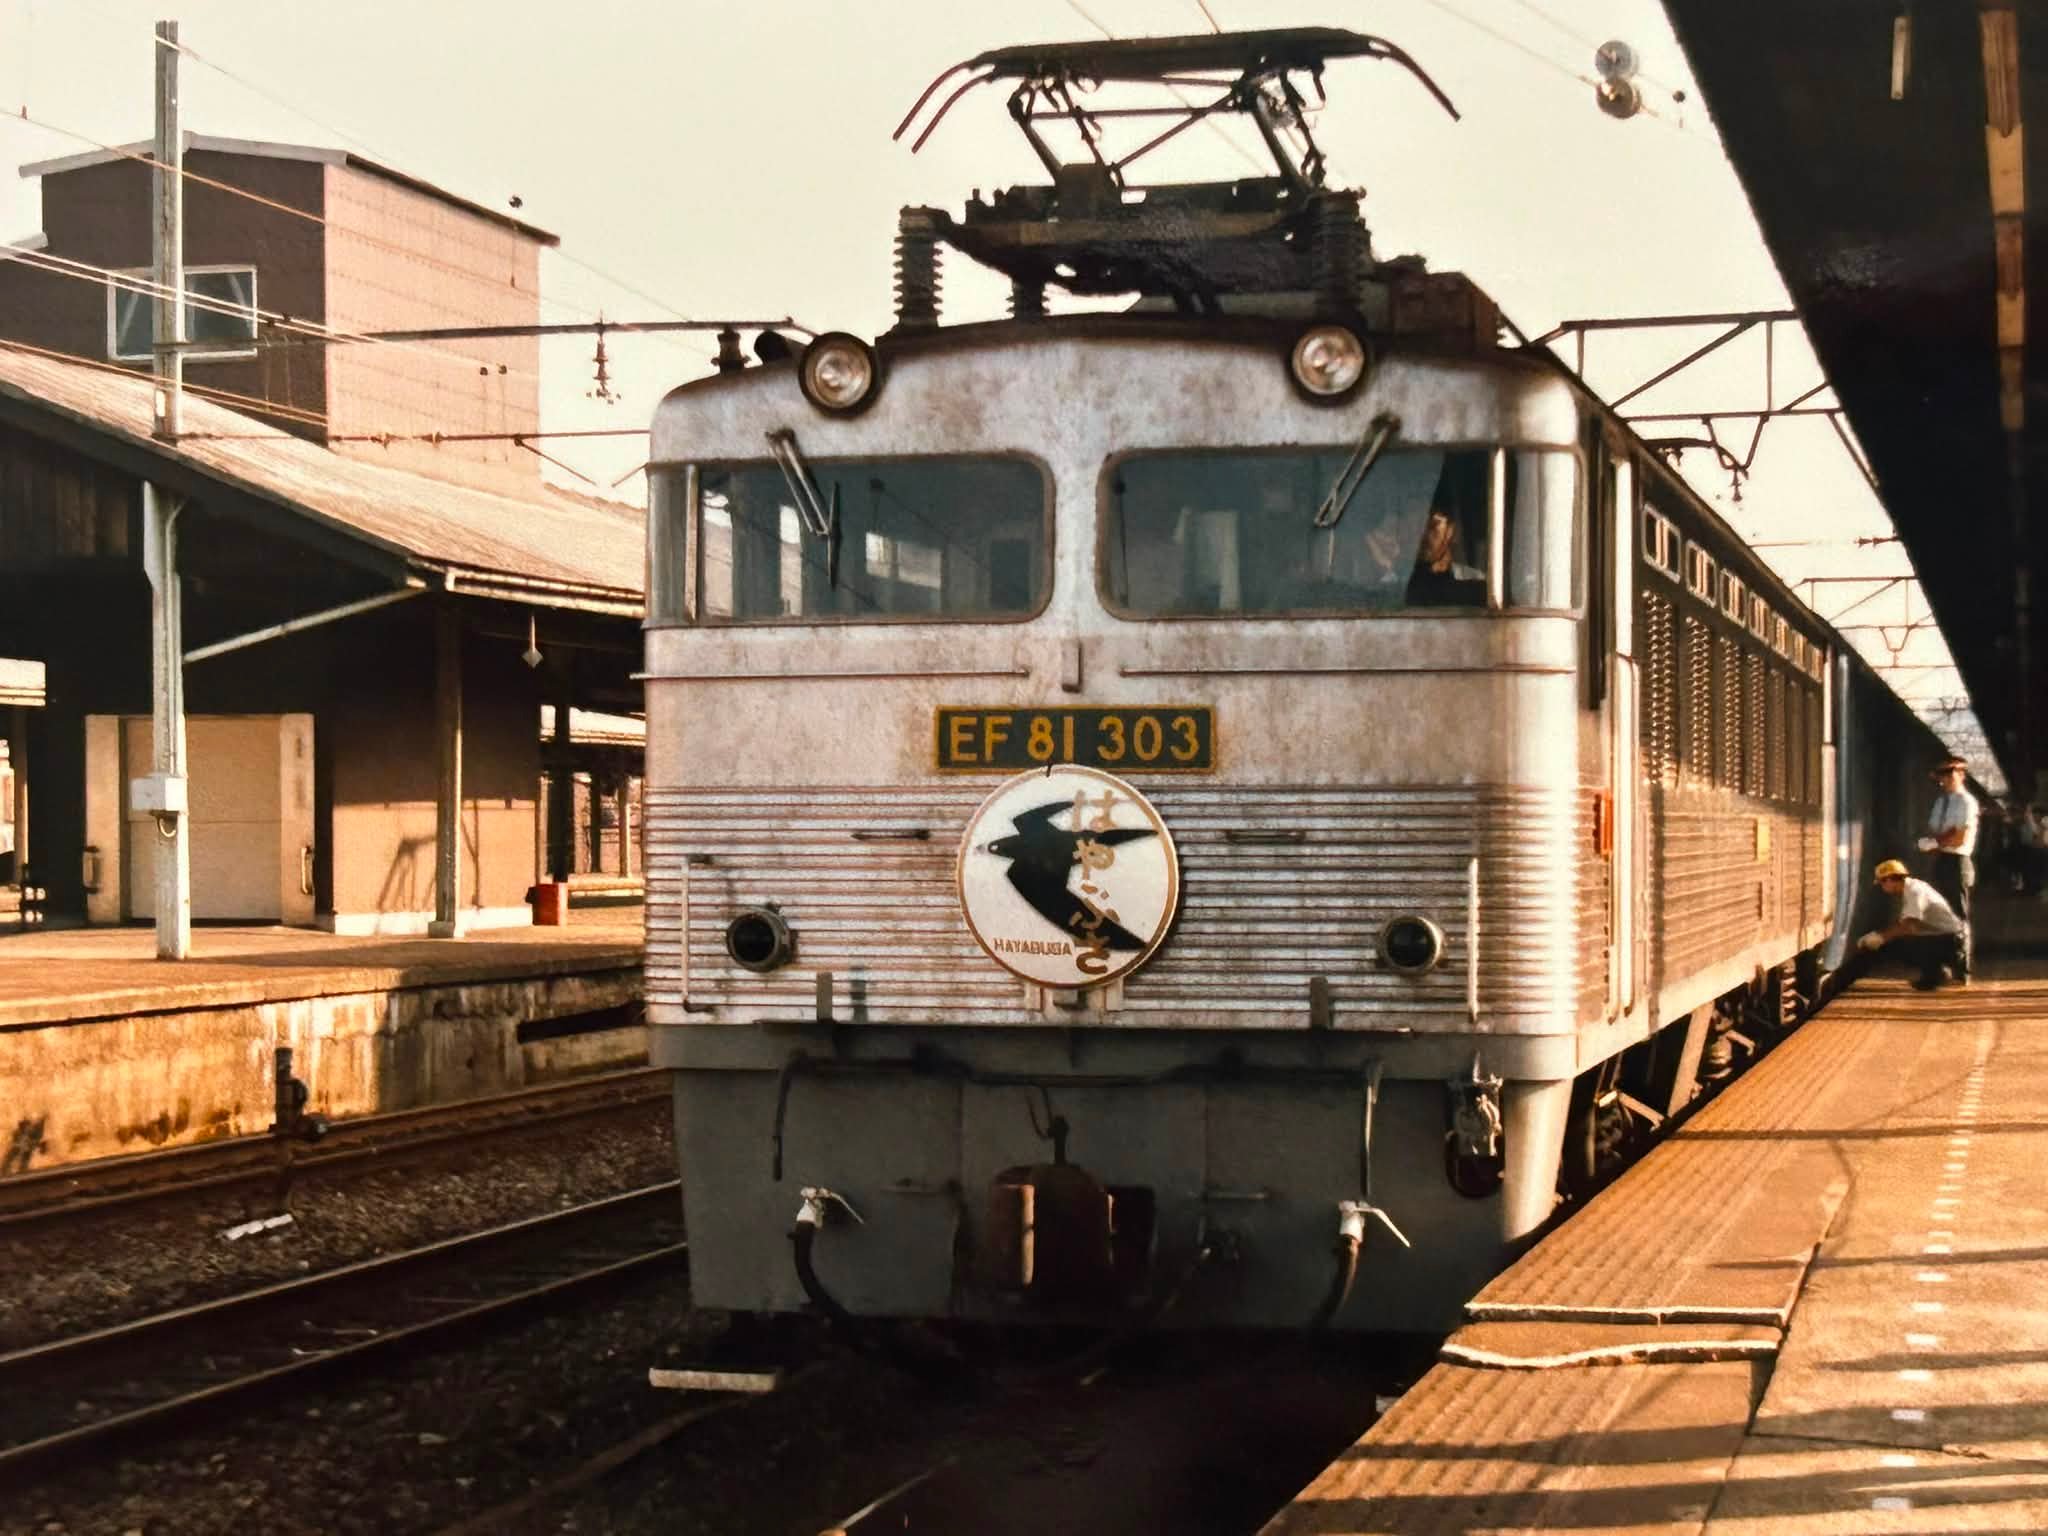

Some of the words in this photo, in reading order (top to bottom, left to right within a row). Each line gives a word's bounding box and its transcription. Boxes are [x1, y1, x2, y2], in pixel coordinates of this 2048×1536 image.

[951, 716, 1012, 762] EF
[1027, 716, 1074, 761] 81
[1098, 715, 1199, 761] 303
[1069, 789, 1132, 975] はやぶさ
